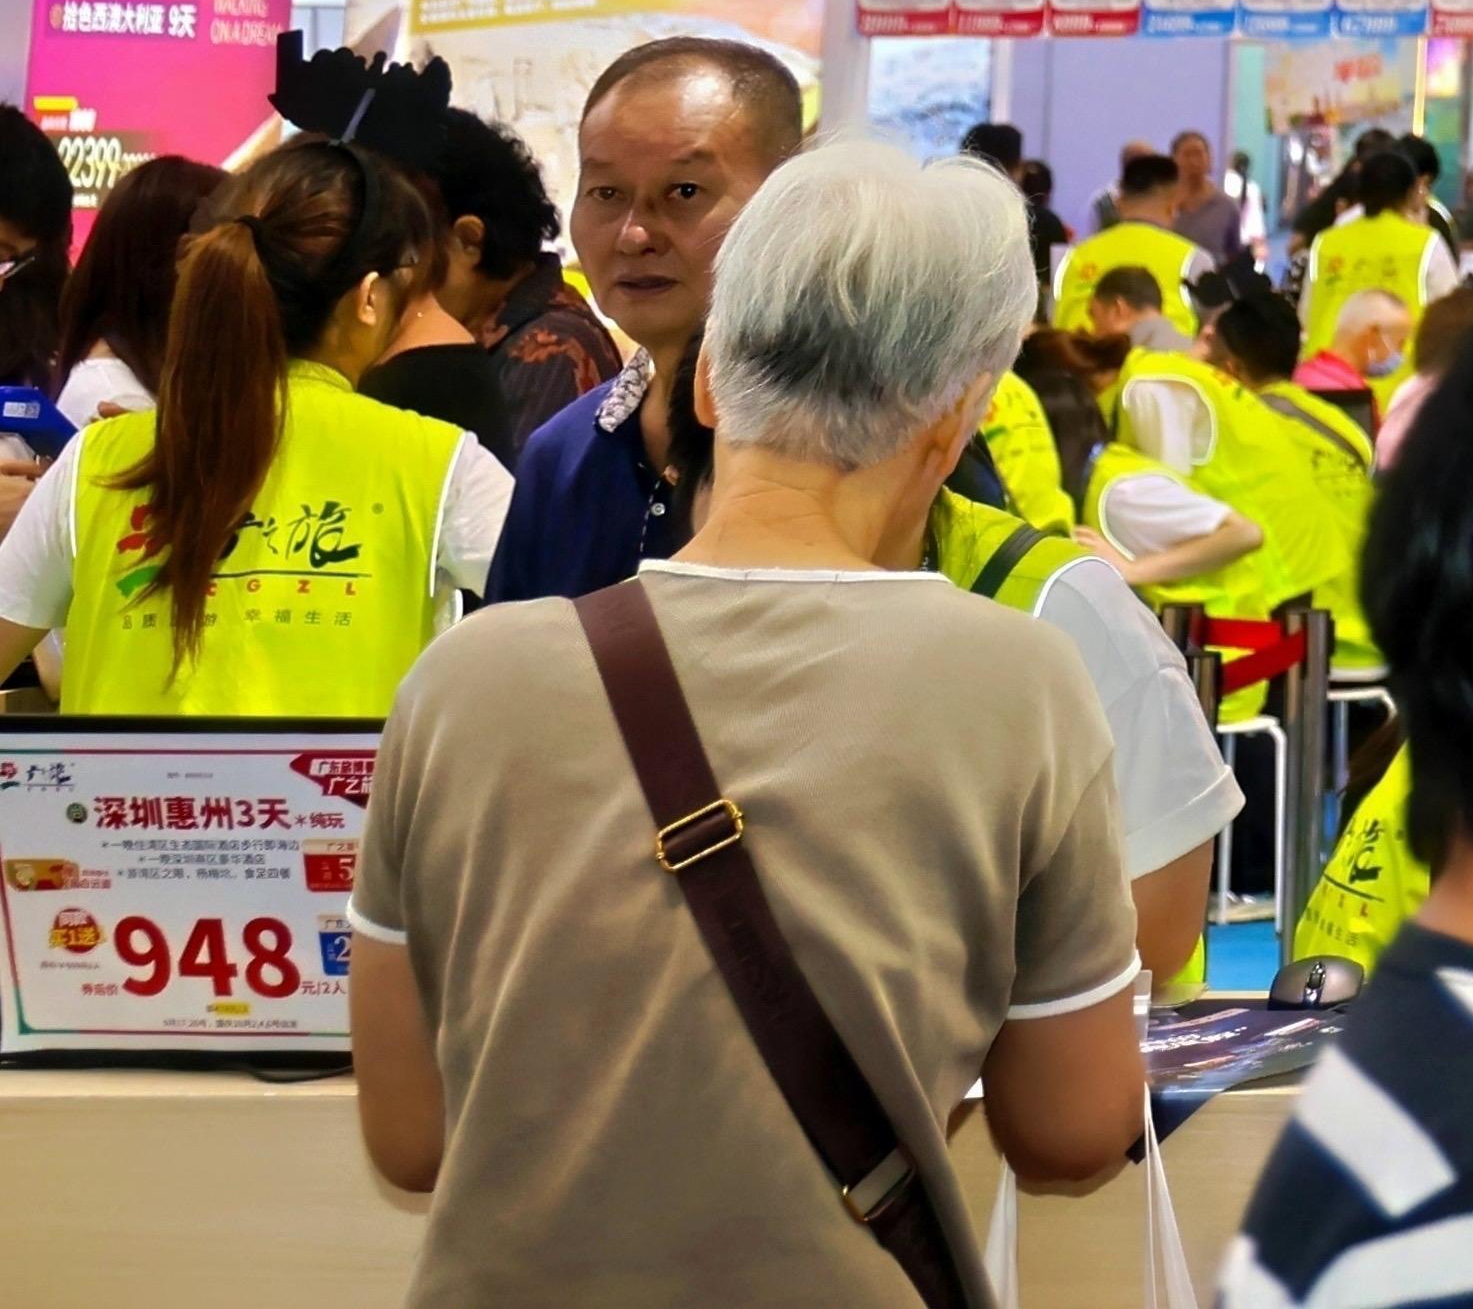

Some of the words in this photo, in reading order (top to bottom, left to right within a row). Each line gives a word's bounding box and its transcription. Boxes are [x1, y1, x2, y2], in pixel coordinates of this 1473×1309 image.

[94, 797, 292, 830] 深圳惠州3天
[113, 915, 301, 998] 948
